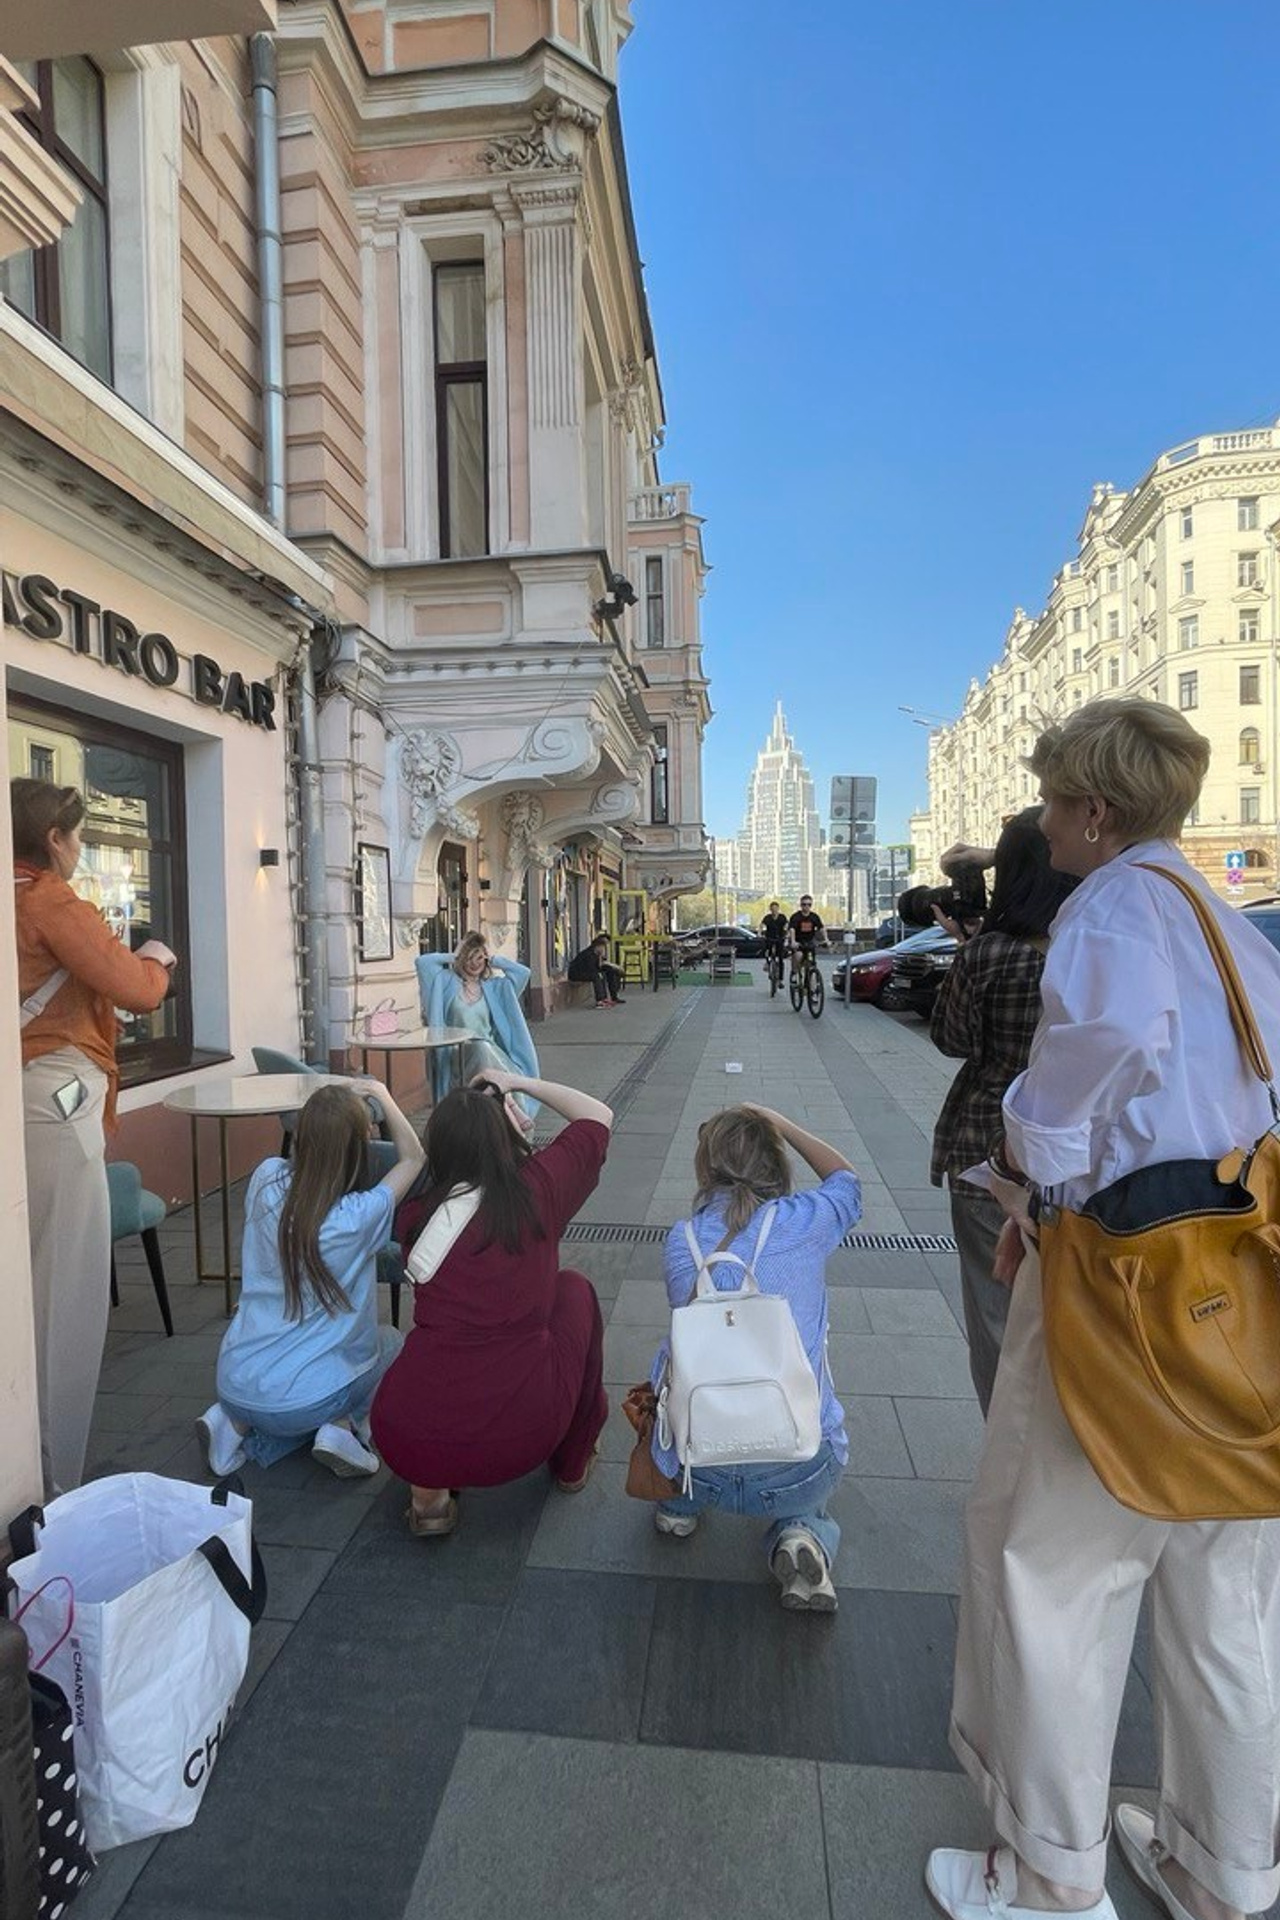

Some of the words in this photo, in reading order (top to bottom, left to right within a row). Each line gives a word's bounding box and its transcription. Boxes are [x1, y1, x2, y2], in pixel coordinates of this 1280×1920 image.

[191, 653, 277, 731] BAR
[73, 1651, 85, 1727] CHANEVIA
[183, 1704, 232, 1789] CH
